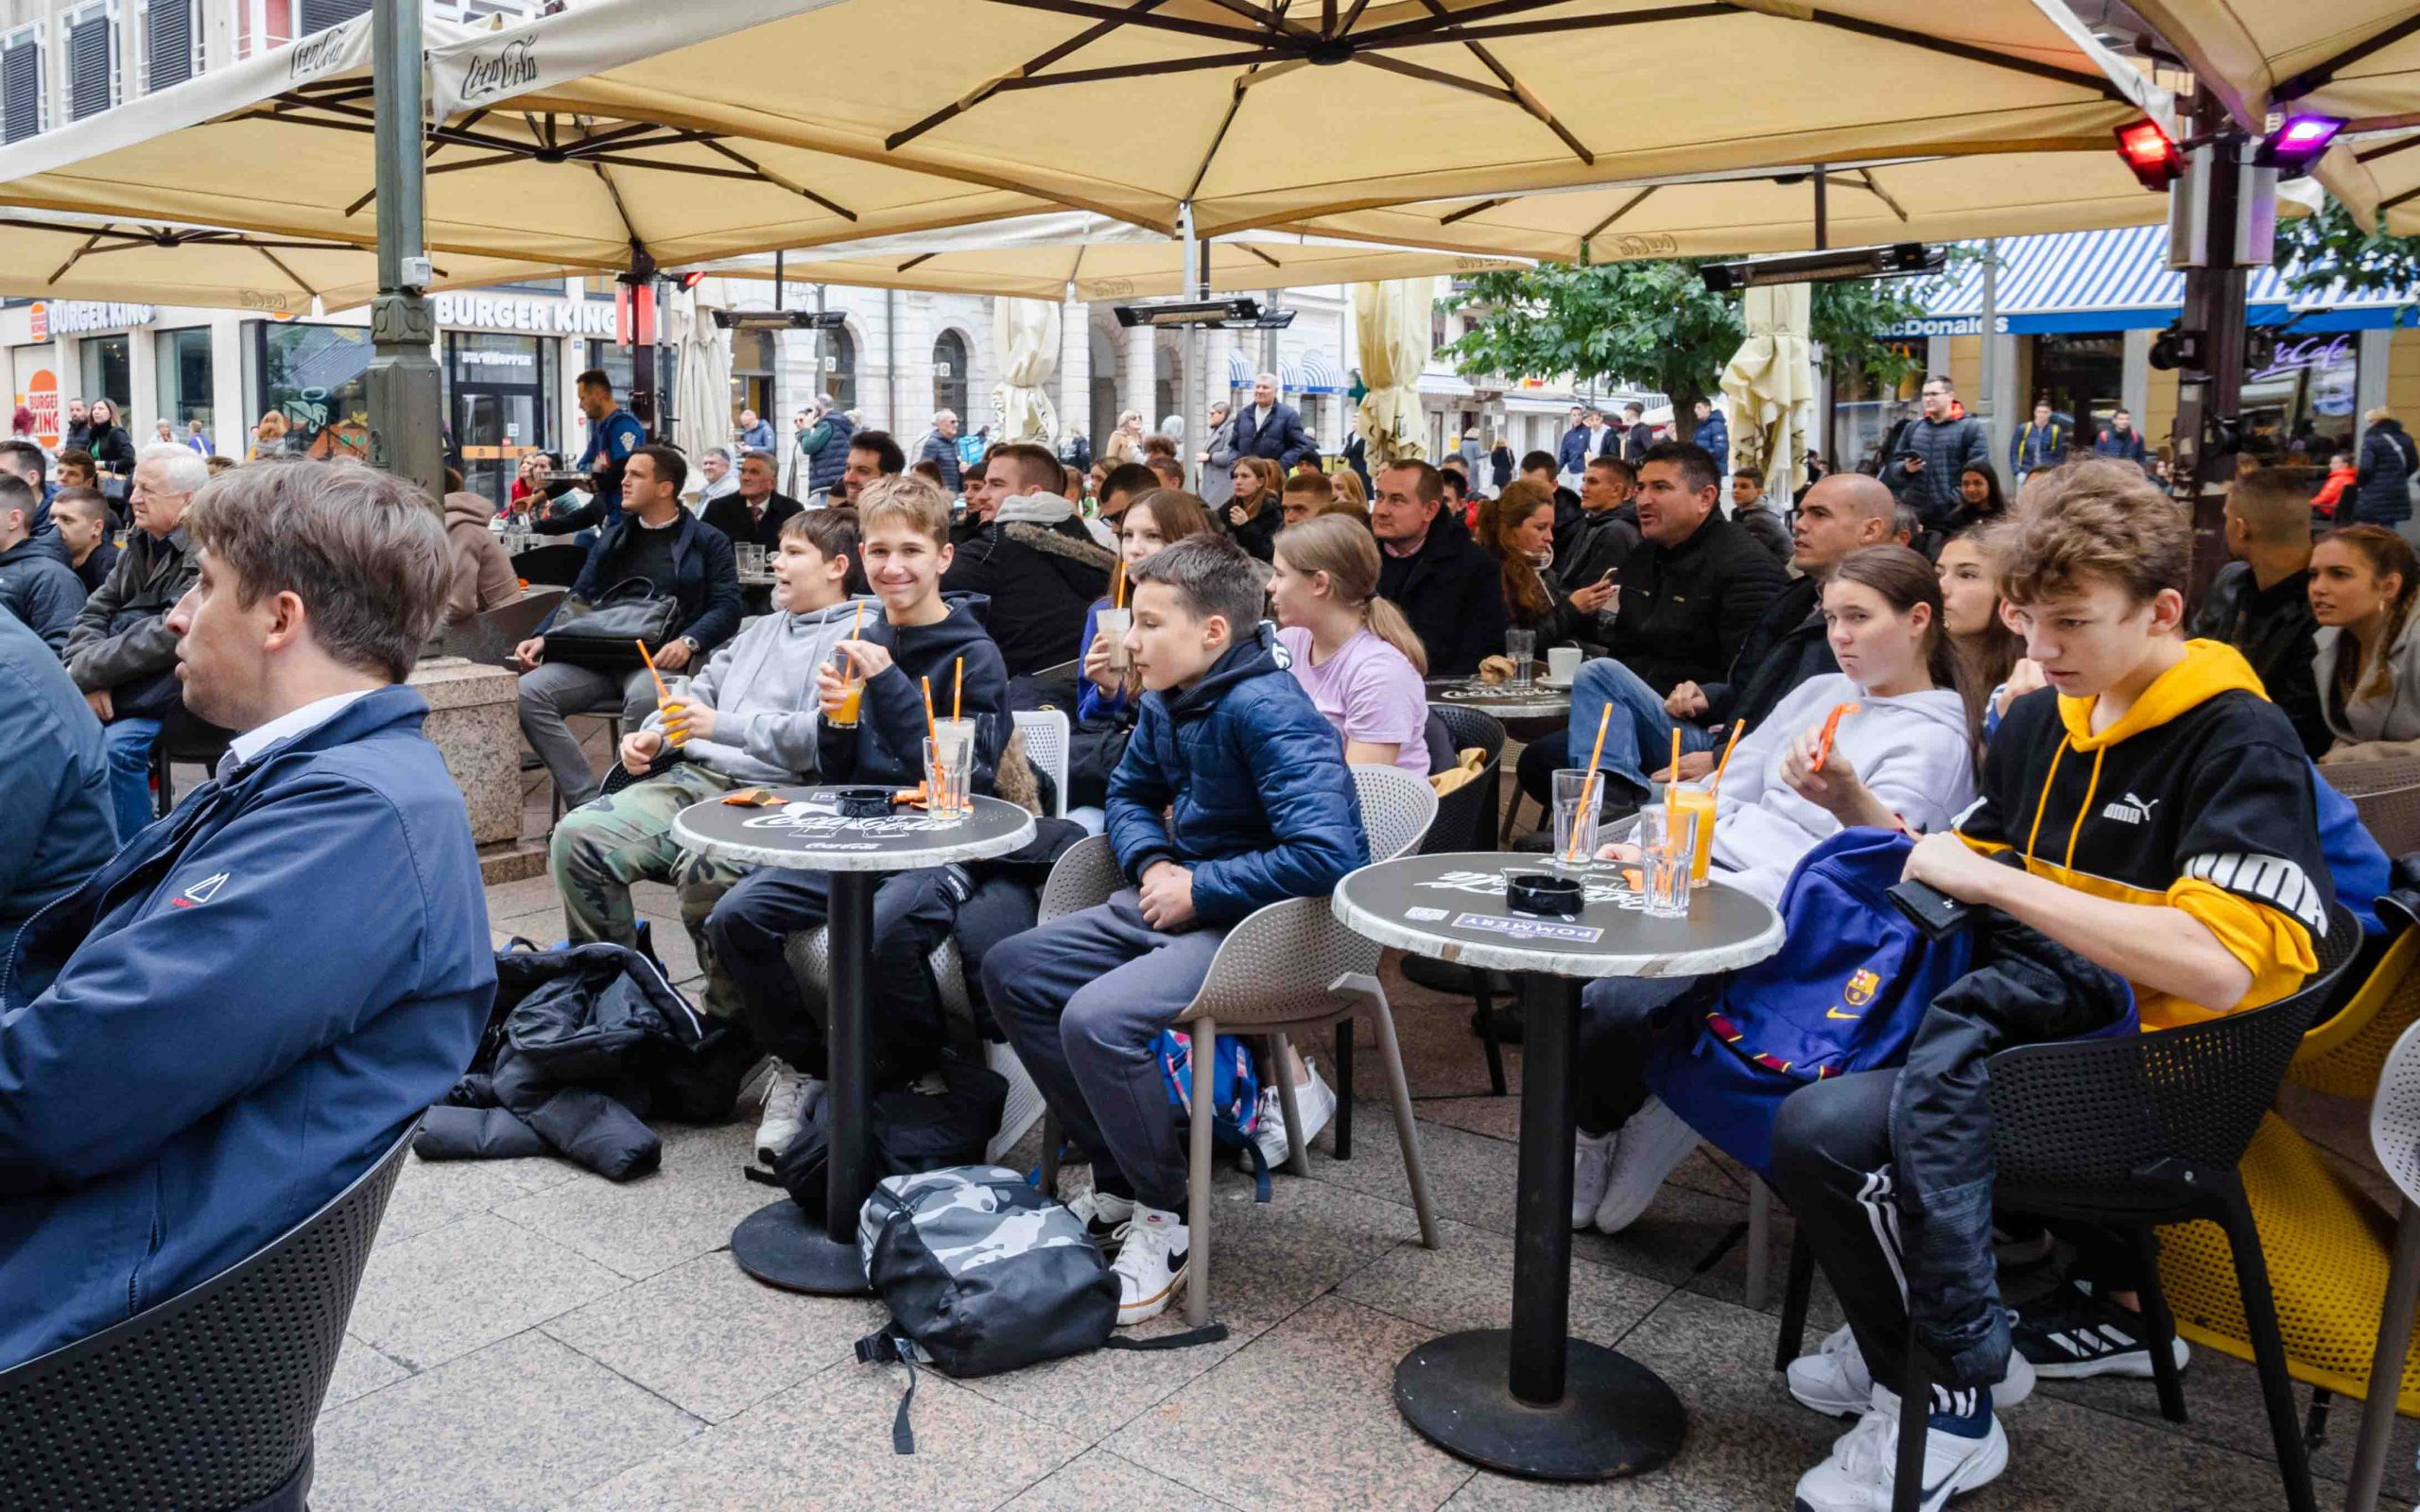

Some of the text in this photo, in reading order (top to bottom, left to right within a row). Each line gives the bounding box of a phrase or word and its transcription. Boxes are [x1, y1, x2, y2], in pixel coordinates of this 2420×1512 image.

[49, 302, 151, 335] BURGER KING
[435, 294, 616, 335] BURGER KING
[1465, 918, 1592, 938] POMMERY
